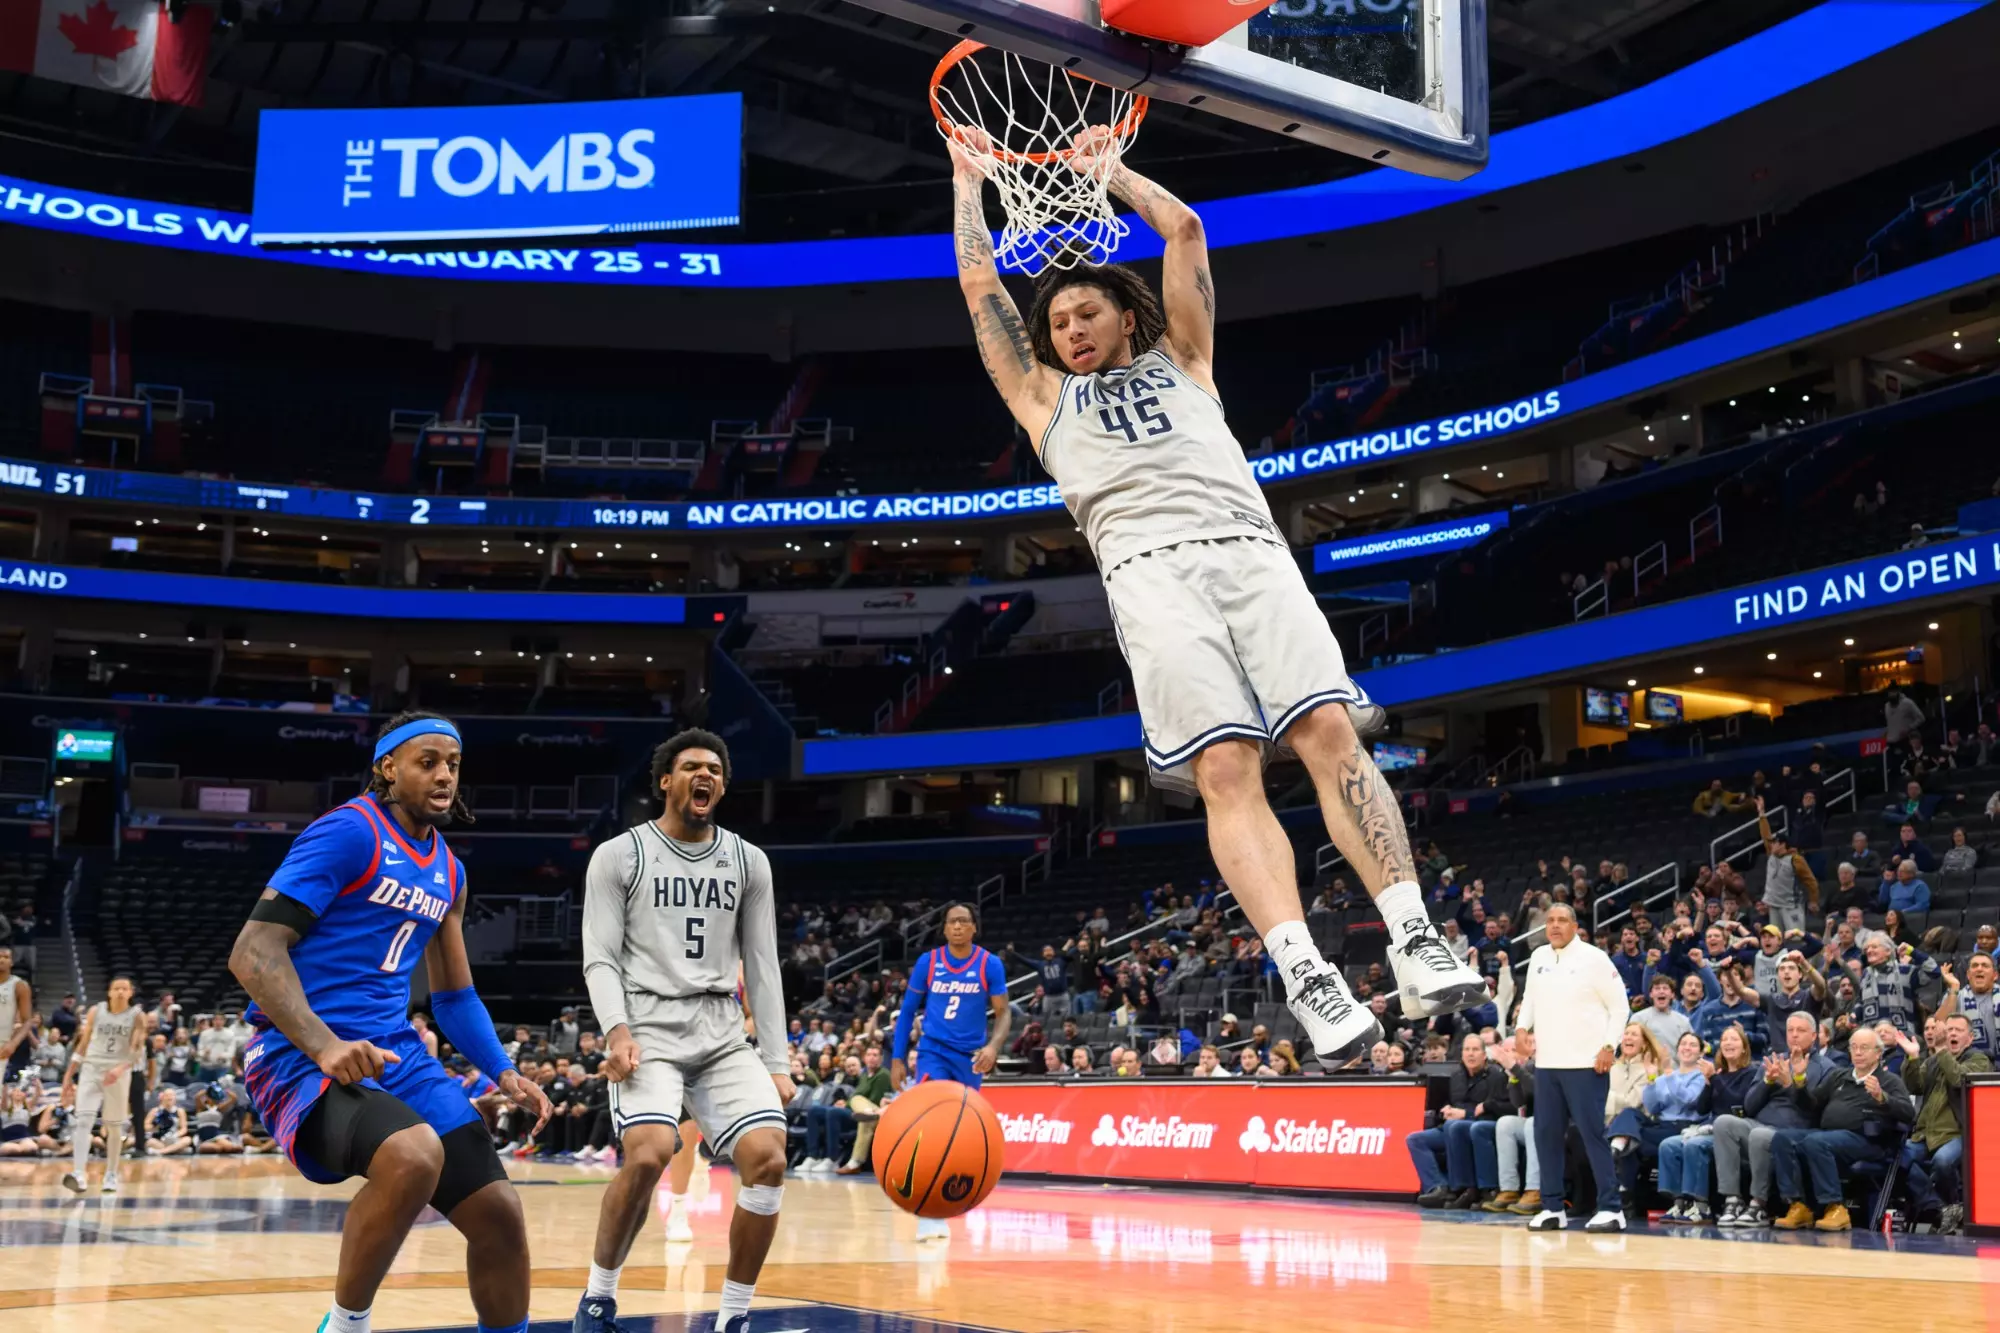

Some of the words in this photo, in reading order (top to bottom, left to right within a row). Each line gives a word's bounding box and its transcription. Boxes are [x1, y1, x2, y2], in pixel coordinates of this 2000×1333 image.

[343, 139, 374, 207] THE
[381, 128, 655, 197] TOMBS
[0, 184, 183, 236] HOOLS
[591, 250, 643, 273] 25
[680, 253, 722, 275] 31
[1075, 367, 1177, 416] HOYAS
[1098, 395, 1174, 444] 45
[1301, 425, 1431, 469] CATHOLIC
[1437, 391, 1560, 441] SCHOOLS
[54, 473, 86, 496] 51
[730, 501, 866, 522] CATHOLIC
[873, 486, 1064, 518] ARCHDIOCESE
[410, 498, 431, 524] 2
[593, 509, 638, 524] 10:19
[641, 510, 669, 525] PM
[1735, 585, 1808, 624] FIND
[1820, 572, 1866, 607] AN
[1879, 548, 1977, 593] OPEN
[653, 877, 737, 912] HOYAS
[379, 919, 418, 972] 0
[685, 916, 705, 960] 5
[943, 995, 960, 1020] 2
[107, 1036, 116, 1053] 2
[995, 1112, 1071, 1145] tateFarm
